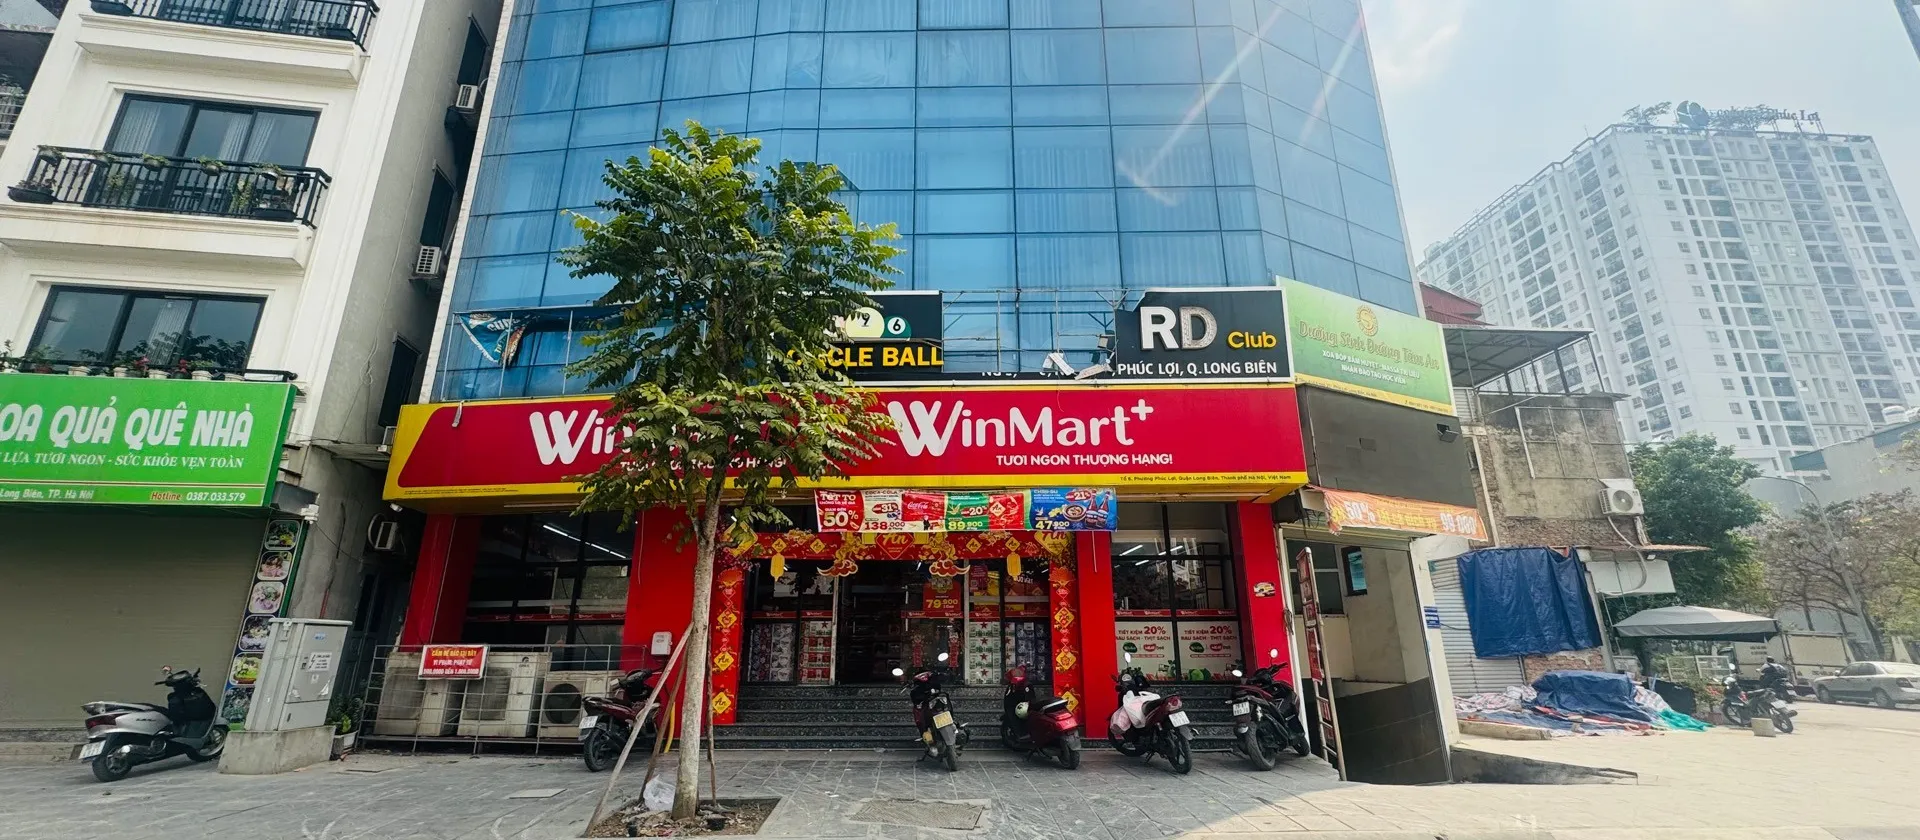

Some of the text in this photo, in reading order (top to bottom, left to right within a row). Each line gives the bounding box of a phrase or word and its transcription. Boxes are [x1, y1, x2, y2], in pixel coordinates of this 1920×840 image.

[893, 318, 901, 332] 6
[1140, 306, 1218, 349] RD
[1227, 331, 1277, 348] Club
[883, 346, 943, 366] BALL
[1118, 360, 1153, 374] PHÚC
[1159, 362, 1184, 376] LỢI,
[1204, 362, 1240, 374] LONG
[1245, 360, 1277, 374] BIÊN
[49, 396, 117, 448] QUẢ
[124, 402, 187, 450] QUÊ
[190, 403, 254, 447] NHÀ
[4, 452, 30, 465] LỰA
[34, 453, 65, 465] TƯƠI
[68, 454, 106, 465] NGON
[115, 453, 140, 466] SỨC
[143, 453, 177, 467] KHỎE
[182, 456, 206, 470] VẸN
[210, 455, 244, 468] TOÀN
[996, 453, 1173, 467] TƯƠI NGON THƯỢNG HẠNG!
[186, 491, 246, 502] 0387.033.579
[1144, 626, 1167, 634] 20%
[1210, 625, 1232, 634] 20%
